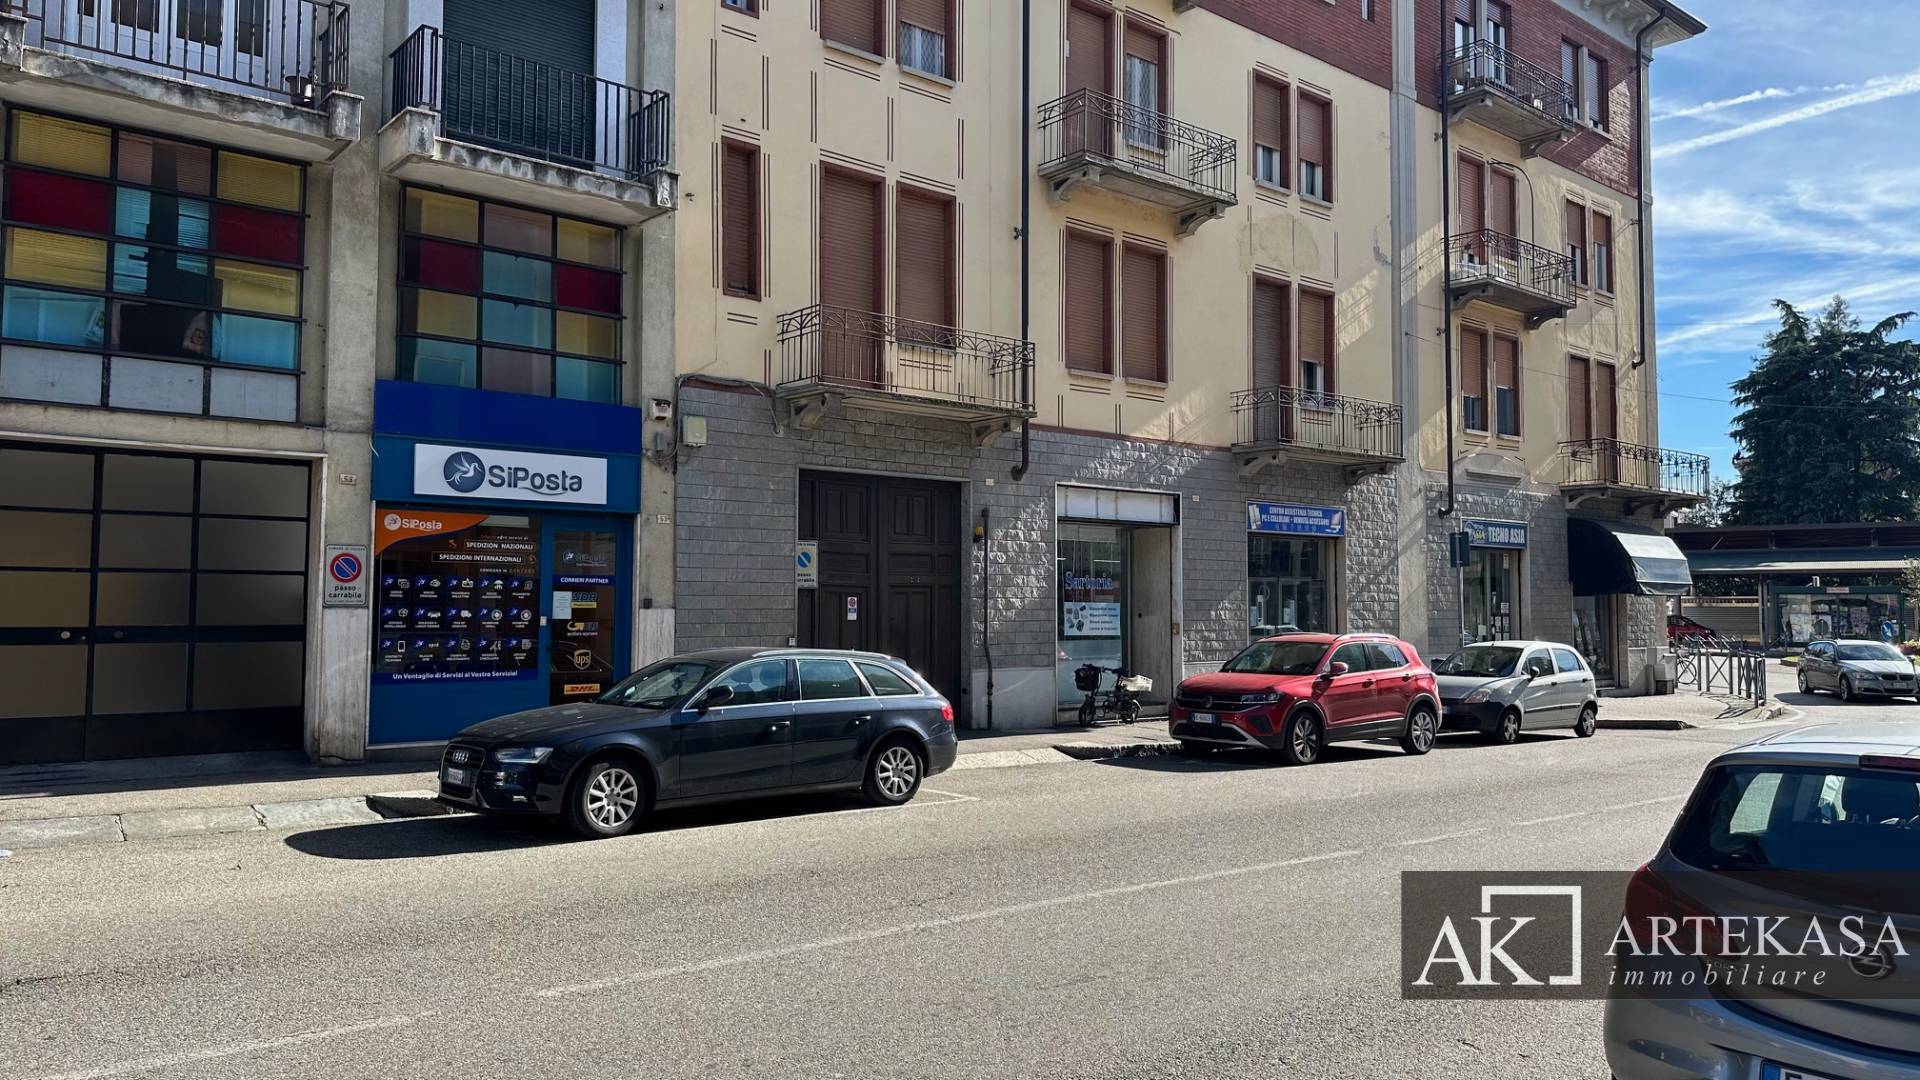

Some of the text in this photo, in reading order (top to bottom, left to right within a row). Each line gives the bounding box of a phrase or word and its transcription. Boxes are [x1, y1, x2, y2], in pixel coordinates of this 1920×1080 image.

[488, 464, 583, 493] SiPosta
[401, 518, 442, 531] SiPosta
[1488, 526, 1509, 543] TECNO
[1510, 528, 1525, 544] ASIA
[473, 555, 522, 563] INTERNAZIONALI
[575, 656, 591, 667] ups
[471, 670, 492, 678] Vostro
